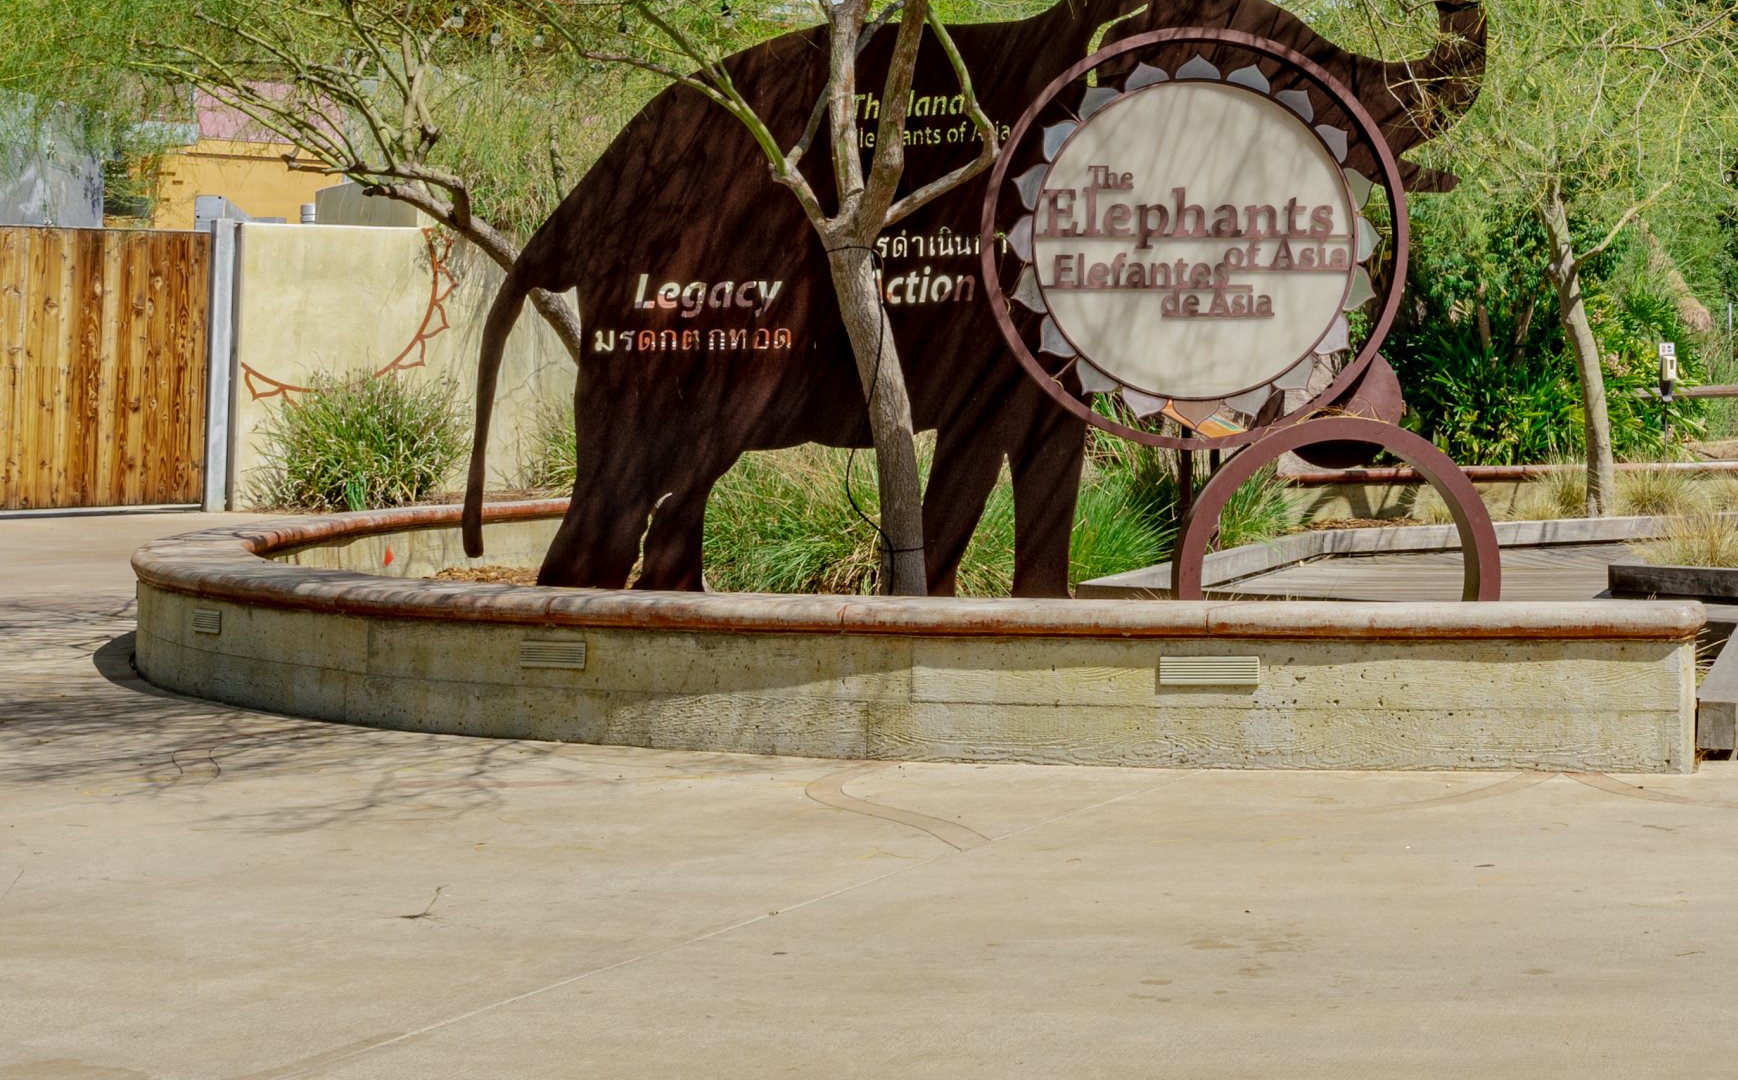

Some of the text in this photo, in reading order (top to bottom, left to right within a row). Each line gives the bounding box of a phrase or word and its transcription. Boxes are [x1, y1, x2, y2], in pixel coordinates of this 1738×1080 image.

[854, 89, 965, 120] Thland
[859, 120, 1011, 149] leants of Aia
[1087, 164, 1134, 190] The
[1043, 186, 1335, 250] Elephants
[1223, 234, 1348, 270] of Asia
[1054, 252, 1231, 289] Elefantes
[633, 273, 783, 318] Legacy
[1161, 288, 1274, 316] de Asia
